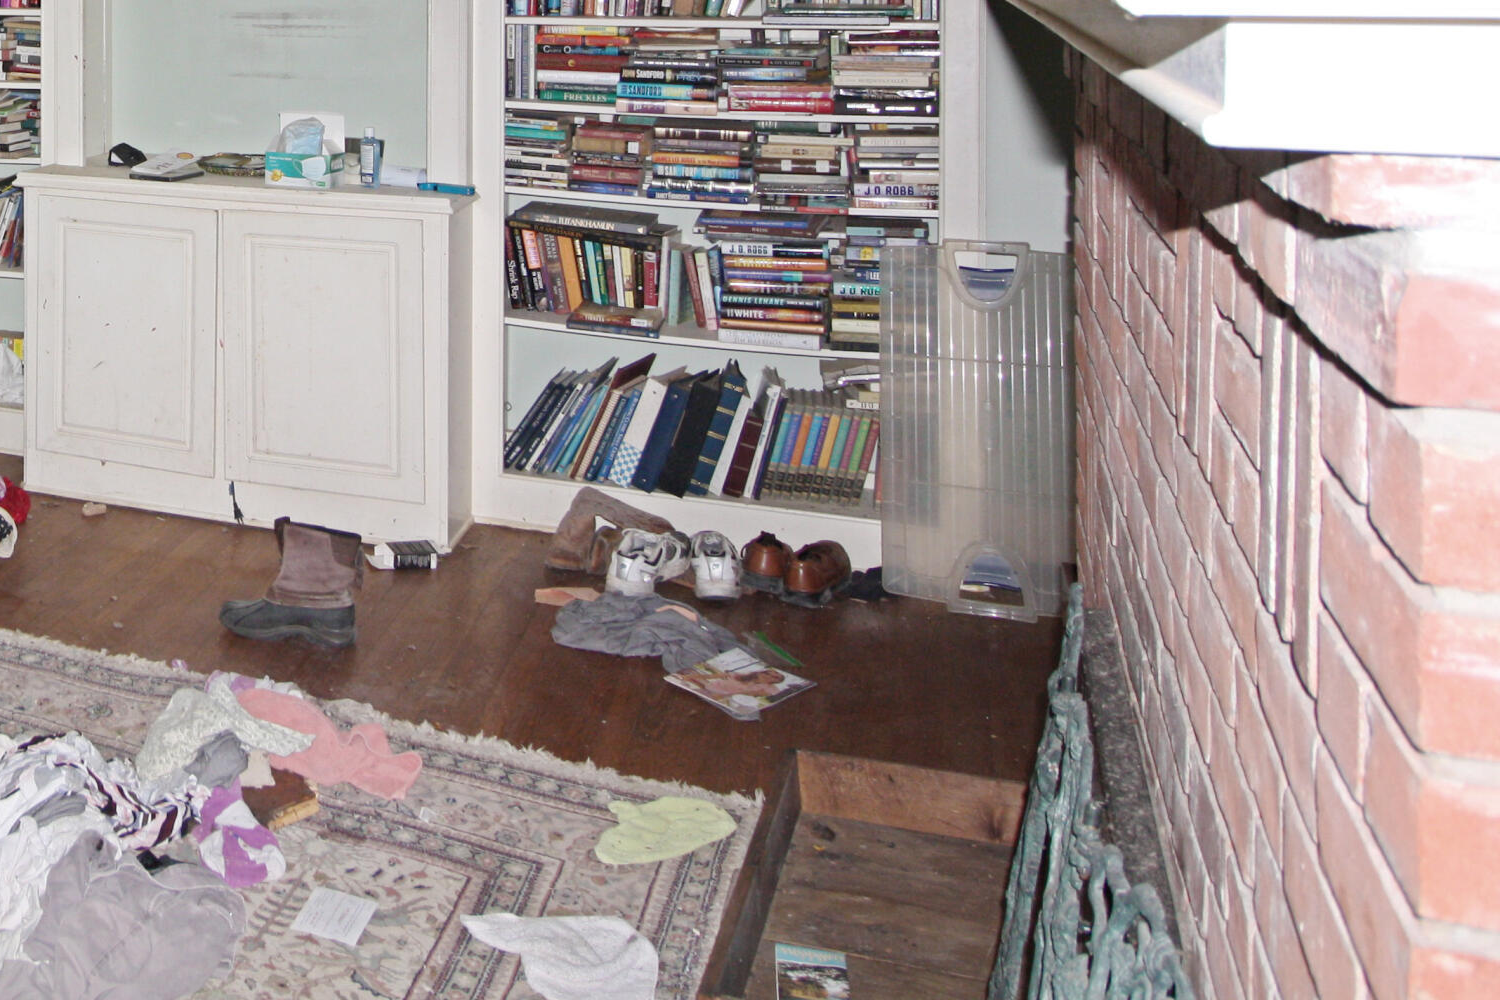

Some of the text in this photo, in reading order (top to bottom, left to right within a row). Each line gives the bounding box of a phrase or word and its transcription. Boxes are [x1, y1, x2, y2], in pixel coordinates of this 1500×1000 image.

[636, 69, 665, 79] SANDFORD
[628, 84, 662, 96] SANDFORD
[564, 92, 607, 102] FRECKLES
[885, 185, 915, 196] ROBB
[507, 260, 520, 299] Shrink Rap
[722, 296, 784, 306] DENNIS LEHANE
[734, 309, 765, 319] WHITE
